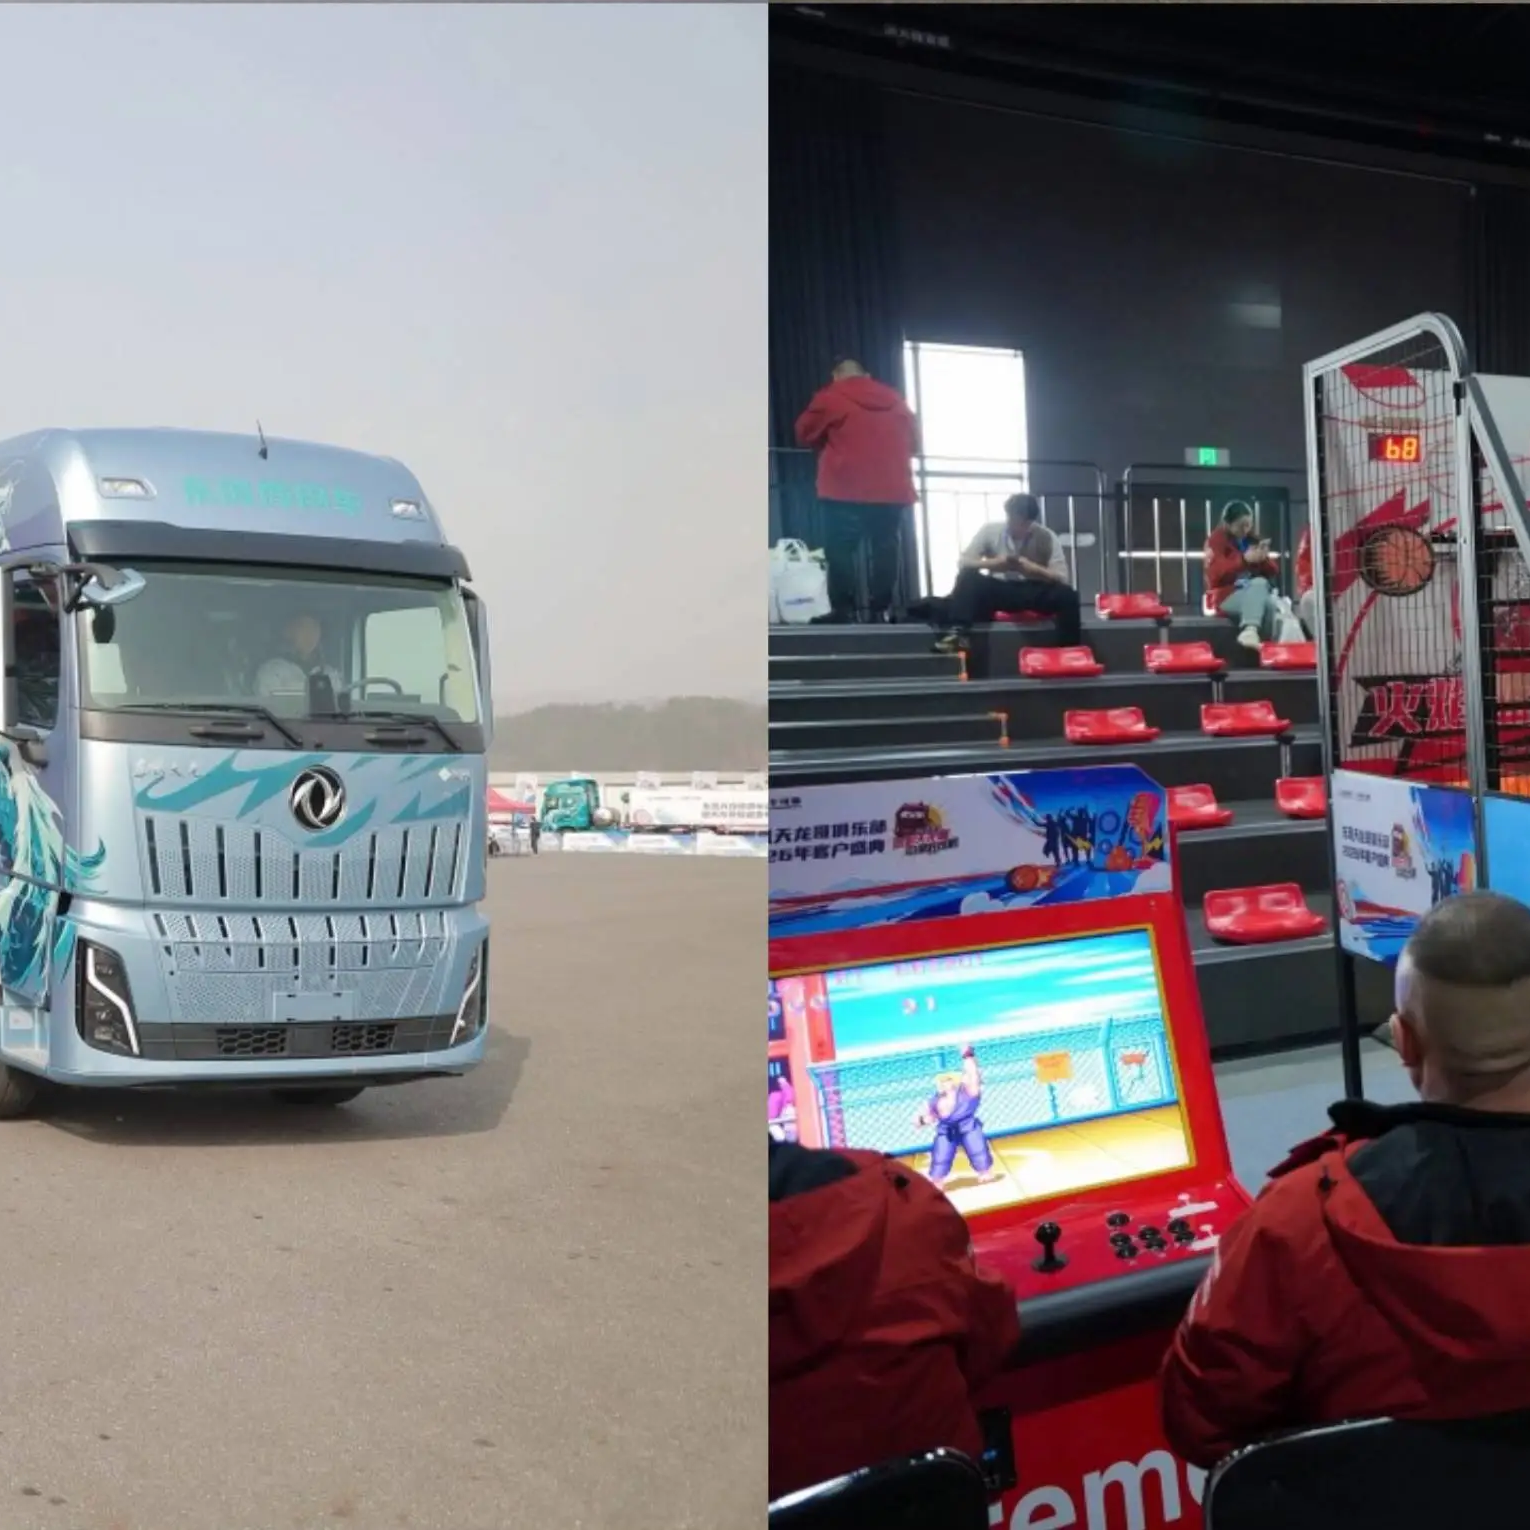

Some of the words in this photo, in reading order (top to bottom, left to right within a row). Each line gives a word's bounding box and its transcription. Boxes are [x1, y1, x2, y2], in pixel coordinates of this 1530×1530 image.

[768, 819, 887, 844] 天龙哥俱乐部
[988, 1449, 1209, 1530] em
